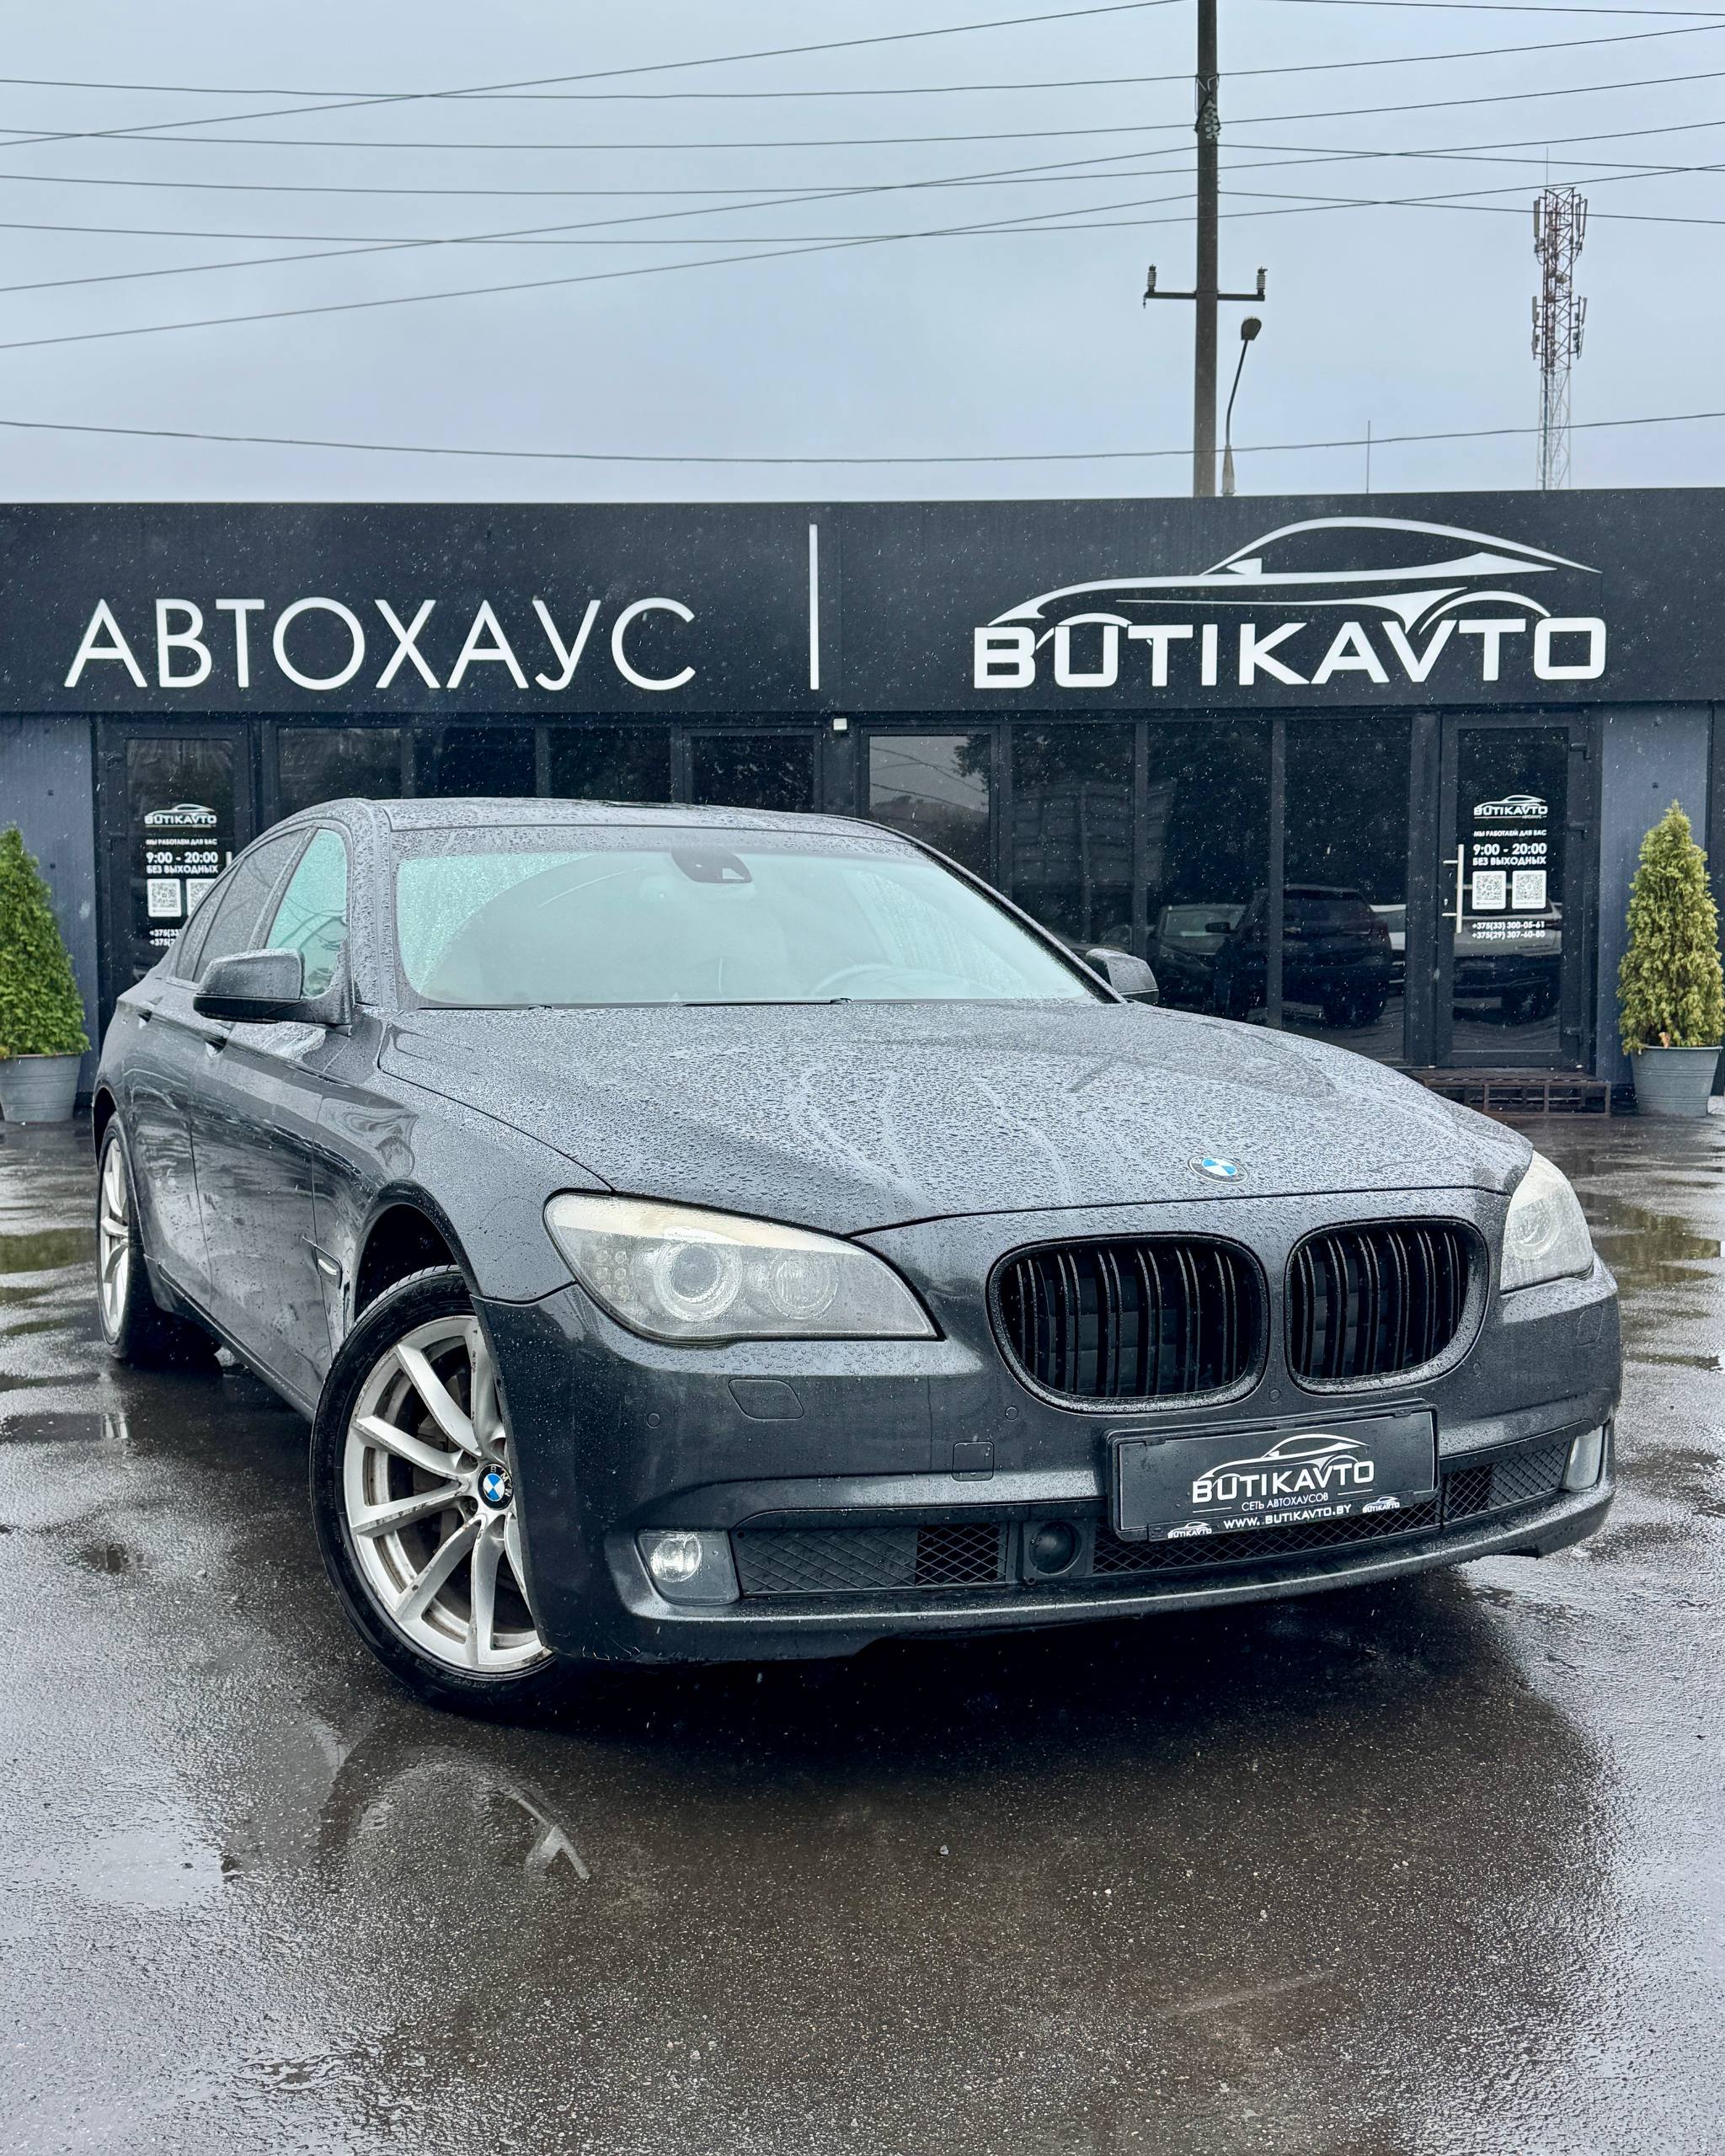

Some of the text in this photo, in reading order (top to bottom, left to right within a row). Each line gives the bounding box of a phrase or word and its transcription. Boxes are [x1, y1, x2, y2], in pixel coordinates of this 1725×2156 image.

[64, 597, 697, 691] АВТОХАУС
[974, 617, 1606, 689] BUTIKAVTO
[1473, 806, 1548, 816] BUTIKAVTO
[1473, 844, 1500, 856] 9:00
[1512, 843, 1547, 855] 20:00
[146, 851, 174, 864] 9:00
[184, 851, 219, 864] 20:00
[1472, 857, 1546, 867] БЕЗ ВЫХОДНЫХ
[146, 864, 219, 875] БЕЗ ВЫХОДНЫХ
[1471, 921, 1546, 931] +375(33) 300-05-61
[1471, 931, 1506, 941] +375(29)
[1192, 1460, 1375, 1503] BUTIKAVTO
[1241, 1492, 1329, 1512] СЕТЬ АВТОХАУСОВ
[1362, 1502, 1401, 1514] BUTIKAVTO
[1167, 1528, 1213, 1540] BUTIKAVTO
